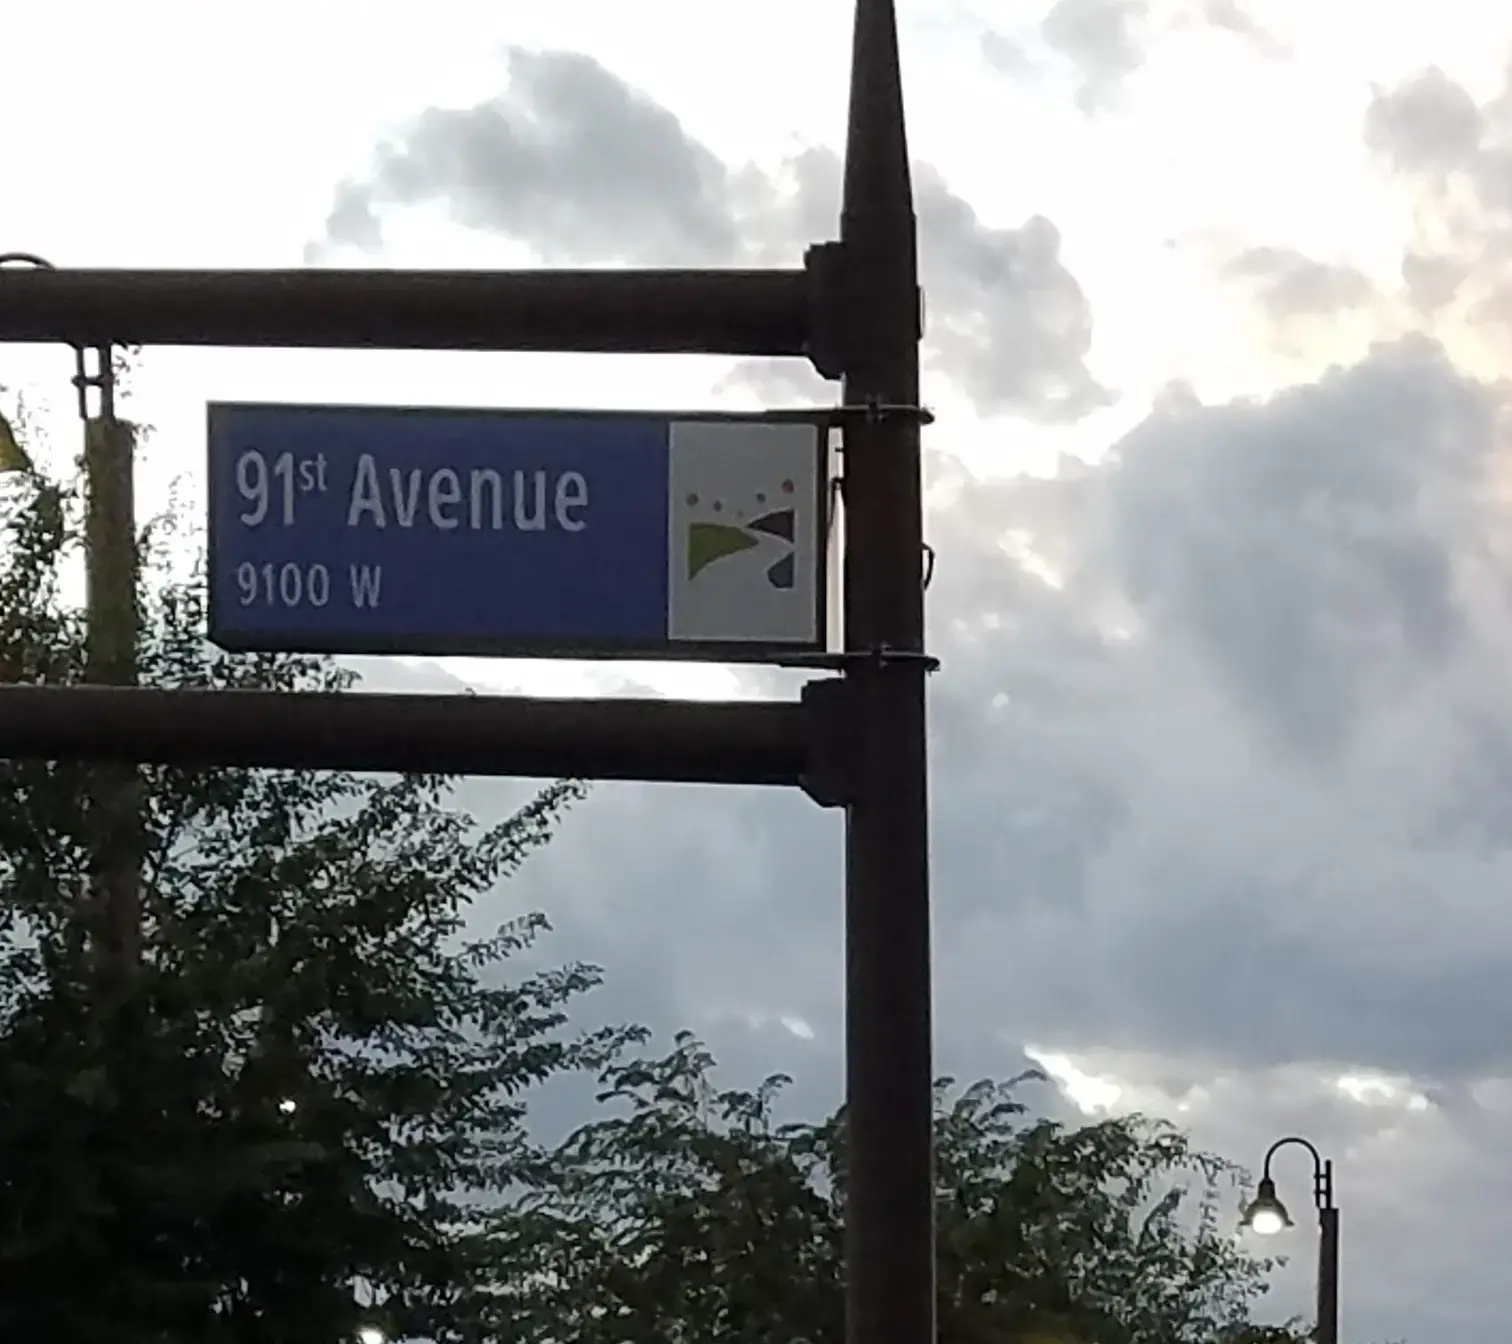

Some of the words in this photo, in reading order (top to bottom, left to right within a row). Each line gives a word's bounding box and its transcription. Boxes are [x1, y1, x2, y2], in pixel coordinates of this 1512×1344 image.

[235, 450, 328, 527] 91st
[347, 453, 589, 532] Avenue
[237, 562, 329, 607] 9100
[350, 565, 382, 608] W
